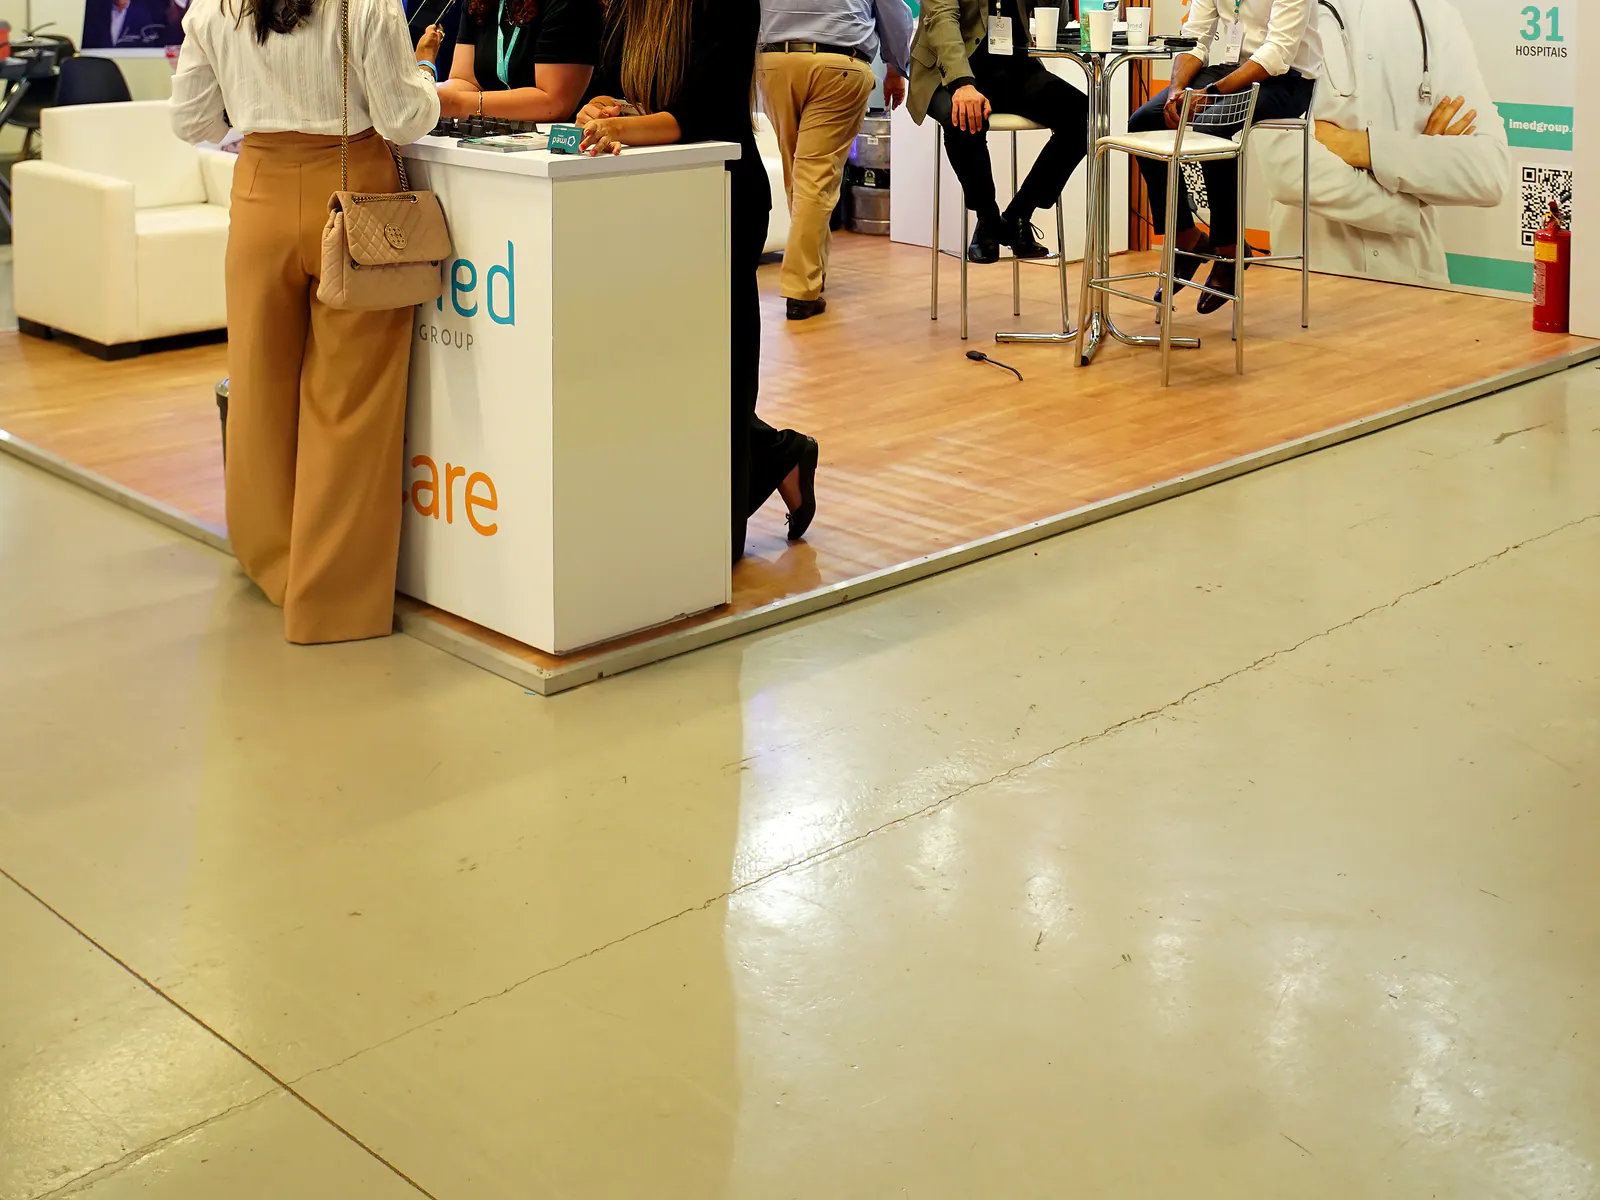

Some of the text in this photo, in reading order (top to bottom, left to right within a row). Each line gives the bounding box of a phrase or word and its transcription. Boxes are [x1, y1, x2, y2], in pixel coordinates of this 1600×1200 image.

[1519, 6, 1564, 42] 31
[1515, 46, 1568, 58] HOSPITAIS
[1508, 118, 1573, 135] imedgroup.
[419, 323, 474, 351] GROUP
[404, 453, 498, 537] are
